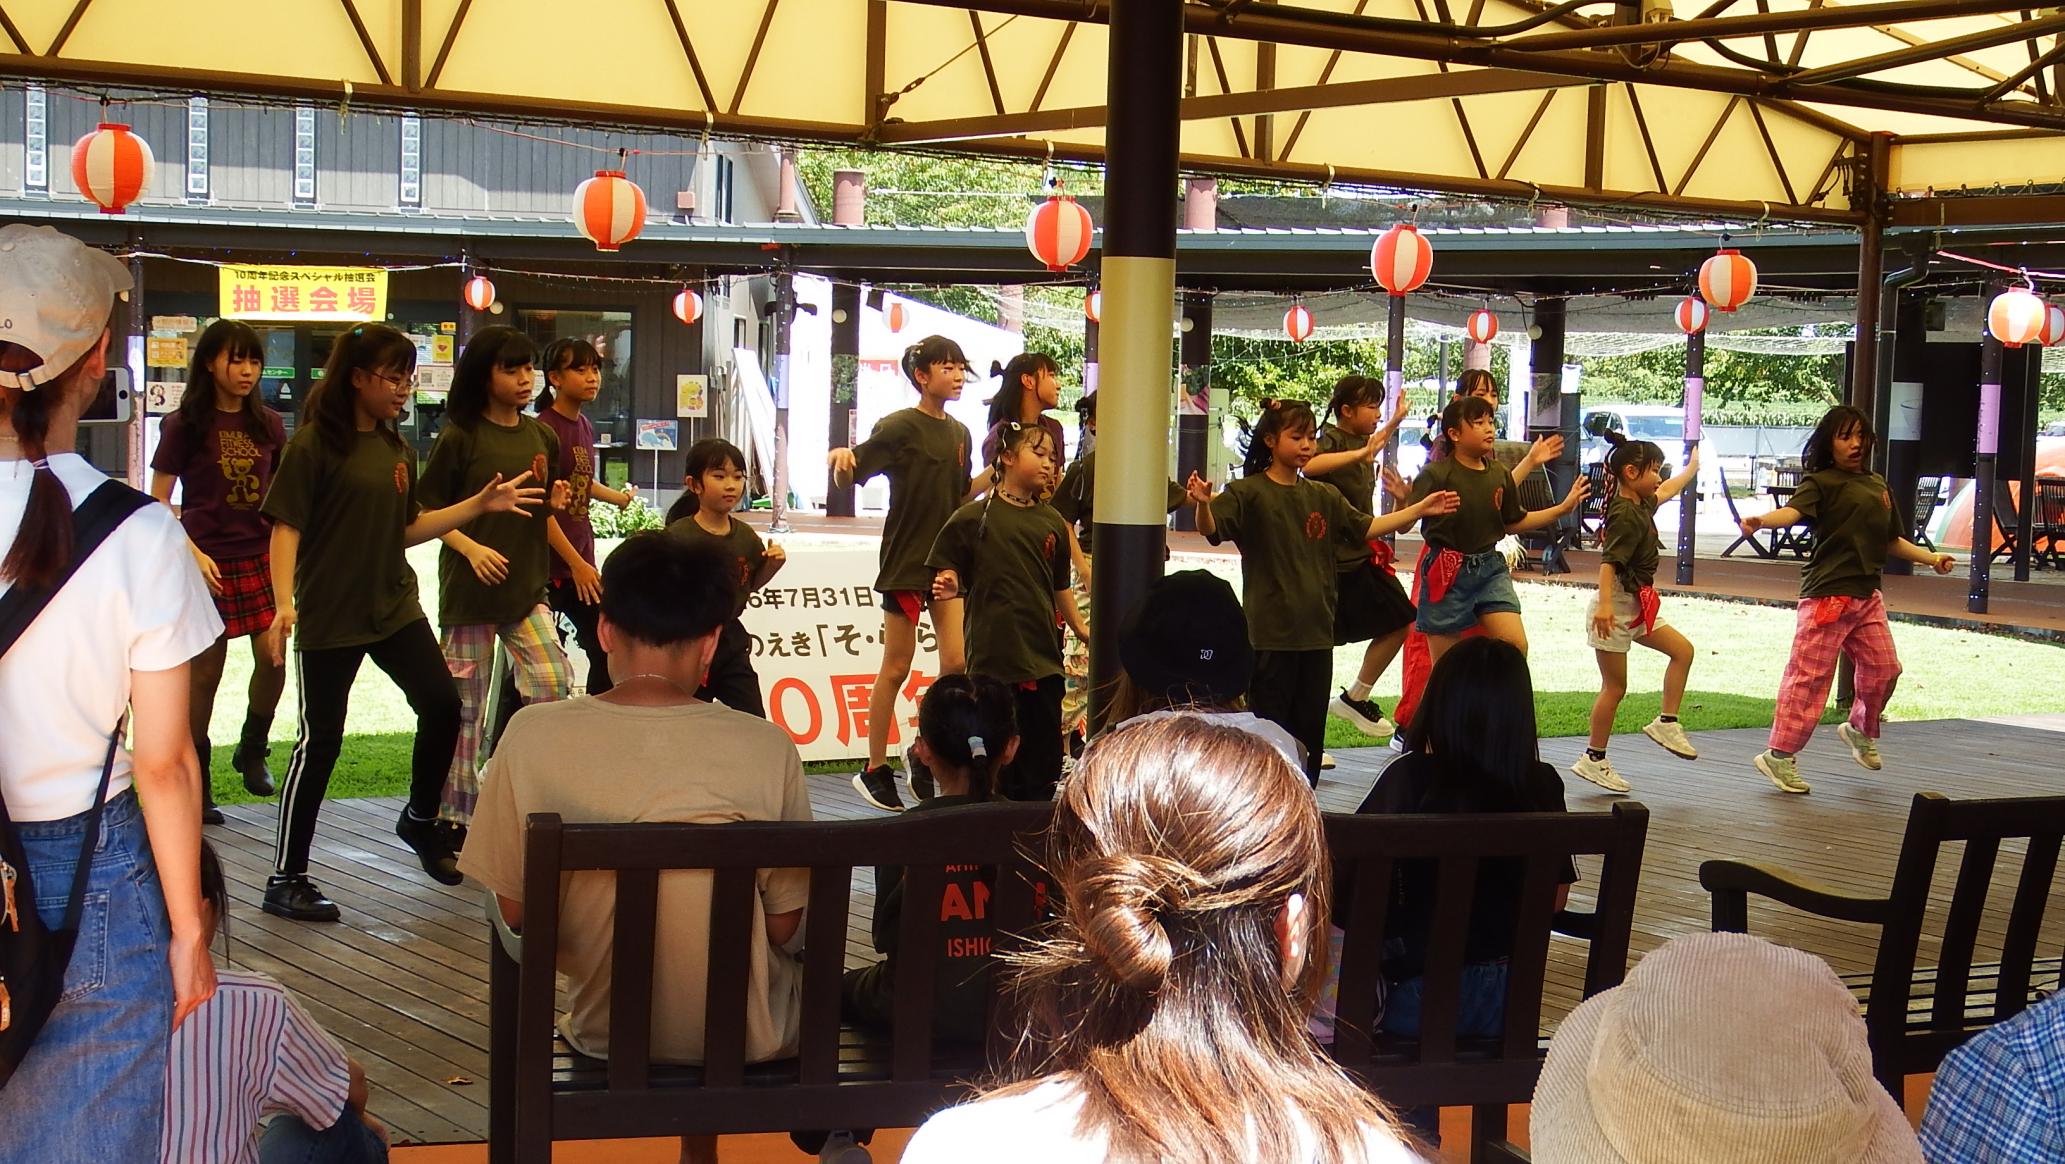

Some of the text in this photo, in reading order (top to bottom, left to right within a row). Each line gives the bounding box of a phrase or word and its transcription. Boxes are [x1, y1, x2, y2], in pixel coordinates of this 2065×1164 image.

[232, 284, 377, 315] 抽選会場
[220, 439, 255, 448] FITNESS
[222, 447, 262, 457] SCHOOL
[745, 586, 874, 610] 6年7月31日
